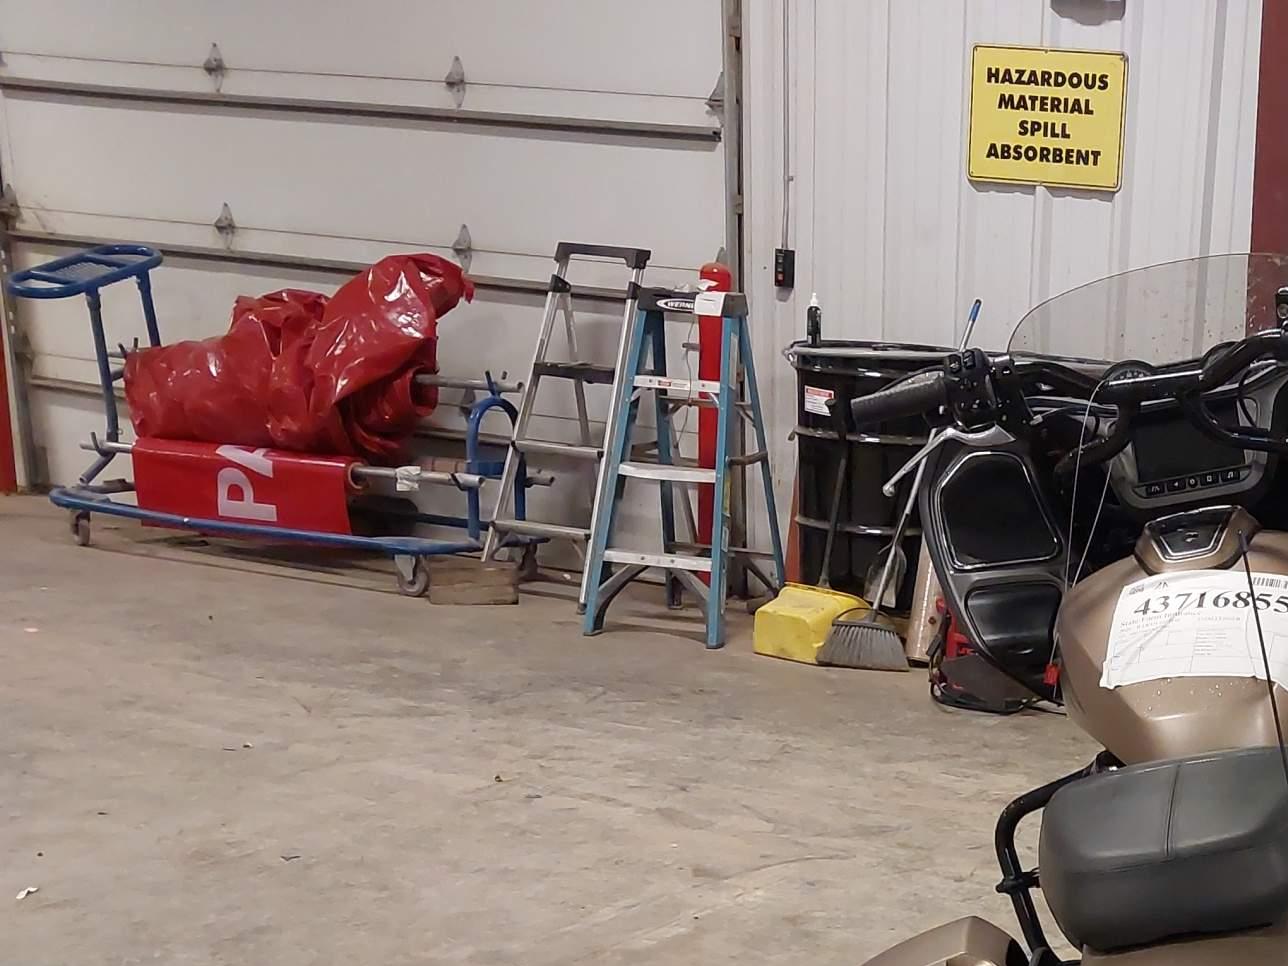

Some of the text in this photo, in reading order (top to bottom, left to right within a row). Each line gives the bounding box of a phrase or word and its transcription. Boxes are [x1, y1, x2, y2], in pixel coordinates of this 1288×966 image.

[986, 67, 1109, 91] HAZARDOUS
[997, 93, 1094, 115] MATERIAL
[1018, 120, 1071, 139] SPILL
[986, 143, 1101, 166] ABSORBENT
